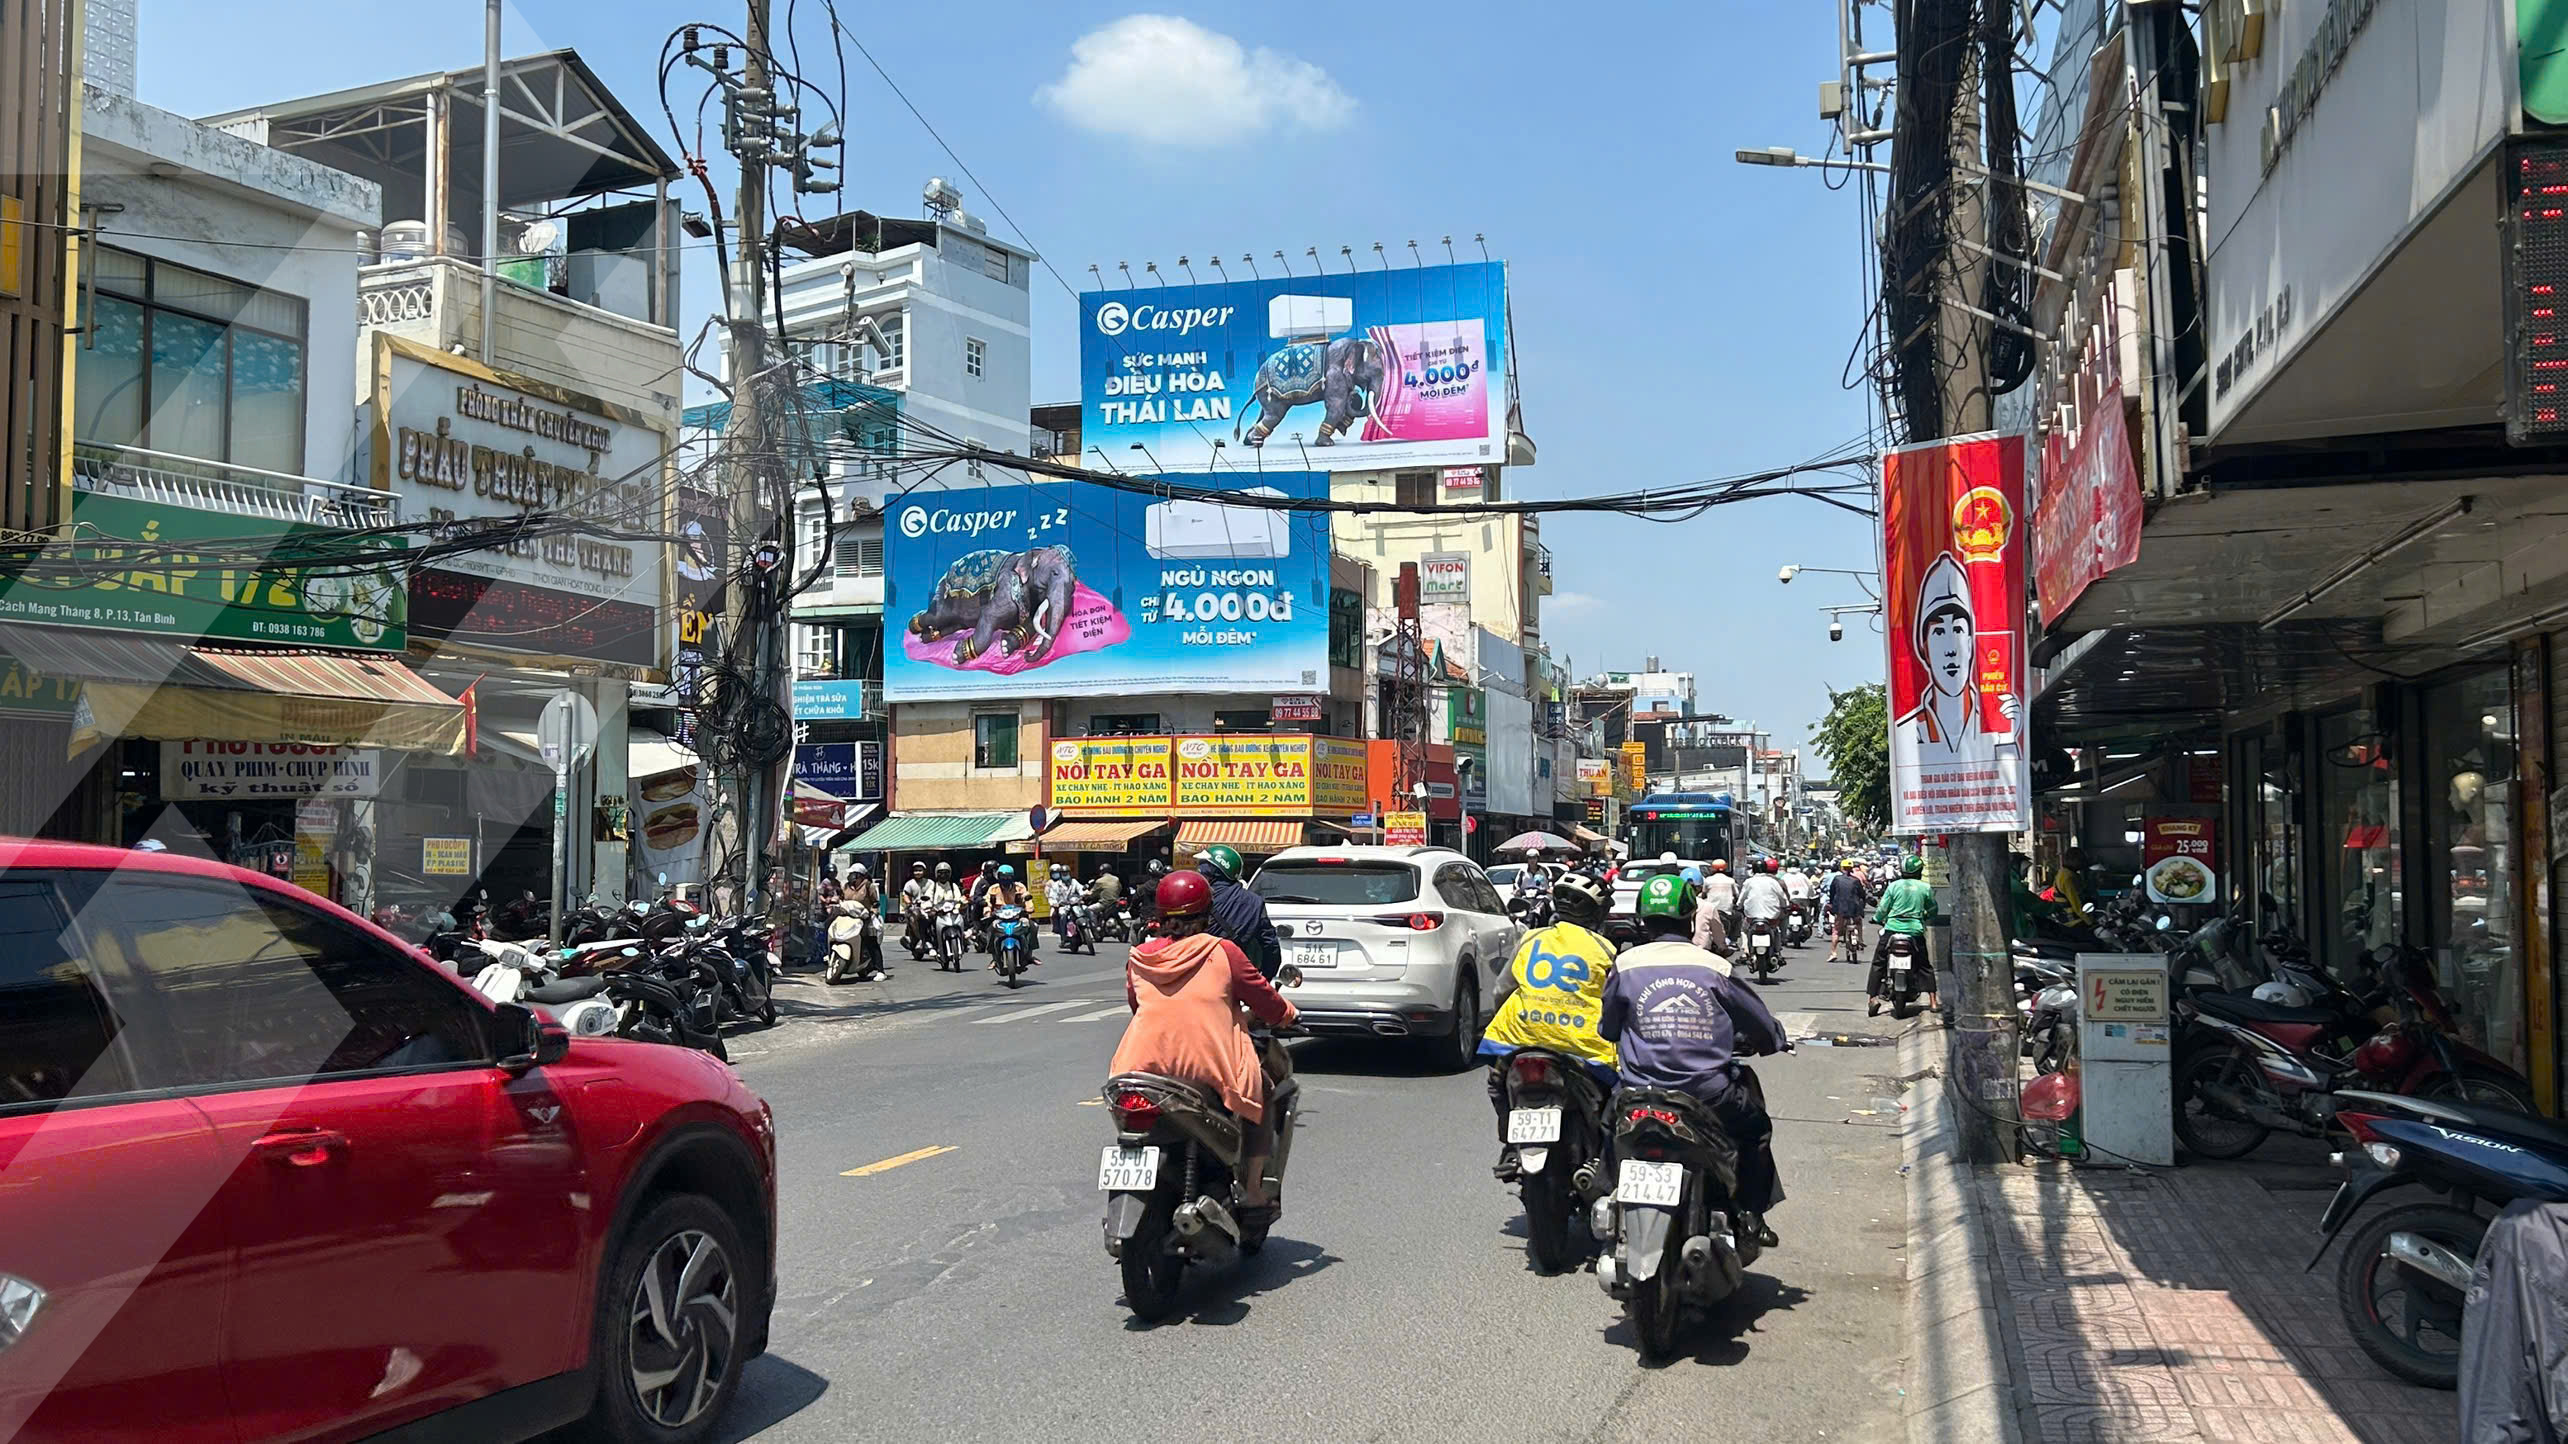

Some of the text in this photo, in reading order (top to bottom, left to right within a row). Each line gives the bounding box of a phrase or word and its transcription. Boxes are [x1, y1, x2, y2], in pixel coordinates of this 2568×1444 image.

[1132, 305, 1234, 335] Casper
[1122, 351, 1208, 369] SỨC MẠNH
[1105, 366, 1225, 396] ĐIỀU HÒA
[1101, 394, 1232, 425] THÁI LAN
[930, 509, 1017, 538] Casper
[1161, 565, 1275, 587] NGỦ NGON
[1427, 563, 1464, 573] VIFON
[1163, 591, 1294, 623] 4.000đ
[134, 610, 152, 623] Tân
[269, 622, 290, 635] 0938
[292, 625, 308, 637] 163
[310, 626, 326, 638] 786
[1182, 625, 1213, 645] MỖI
[1284, 708, 1291, 717] 77
[1293, 708, 1301, 717] 44
[181, 760, 232, 782] QUAY
[333, 756, 371, 776] HÌNH
[1056, 758, 1167, 780] NỒI TAY GA
[1181, 756, 1305, 778] NỒI TAY GA
[1333, 763, 1350, 780] TAY
[1352, 763, 1364, 780] GA
[200, 779, 360, 795] kỹ thuật số
[1126, 795, 1134, 803] 2
[1259, 794, 1269, 802] 2
[1215, 855, 1231, 869] Grab
[1305, 943, 1325, 953] 51K
[1526, 939, 1590, 993] be
[1517, 1112, 1552, 1126] 59-T1
[1511, 1126, 1555, 1140] 647.71
[2428, 1125, 2525, 1153] VISION
[1103, 1168, 1153, 1186] 570.78
[1629, 1164, 1673, 1184] 59-S3
[1622, 1183, 1676, 1202] 214.47
